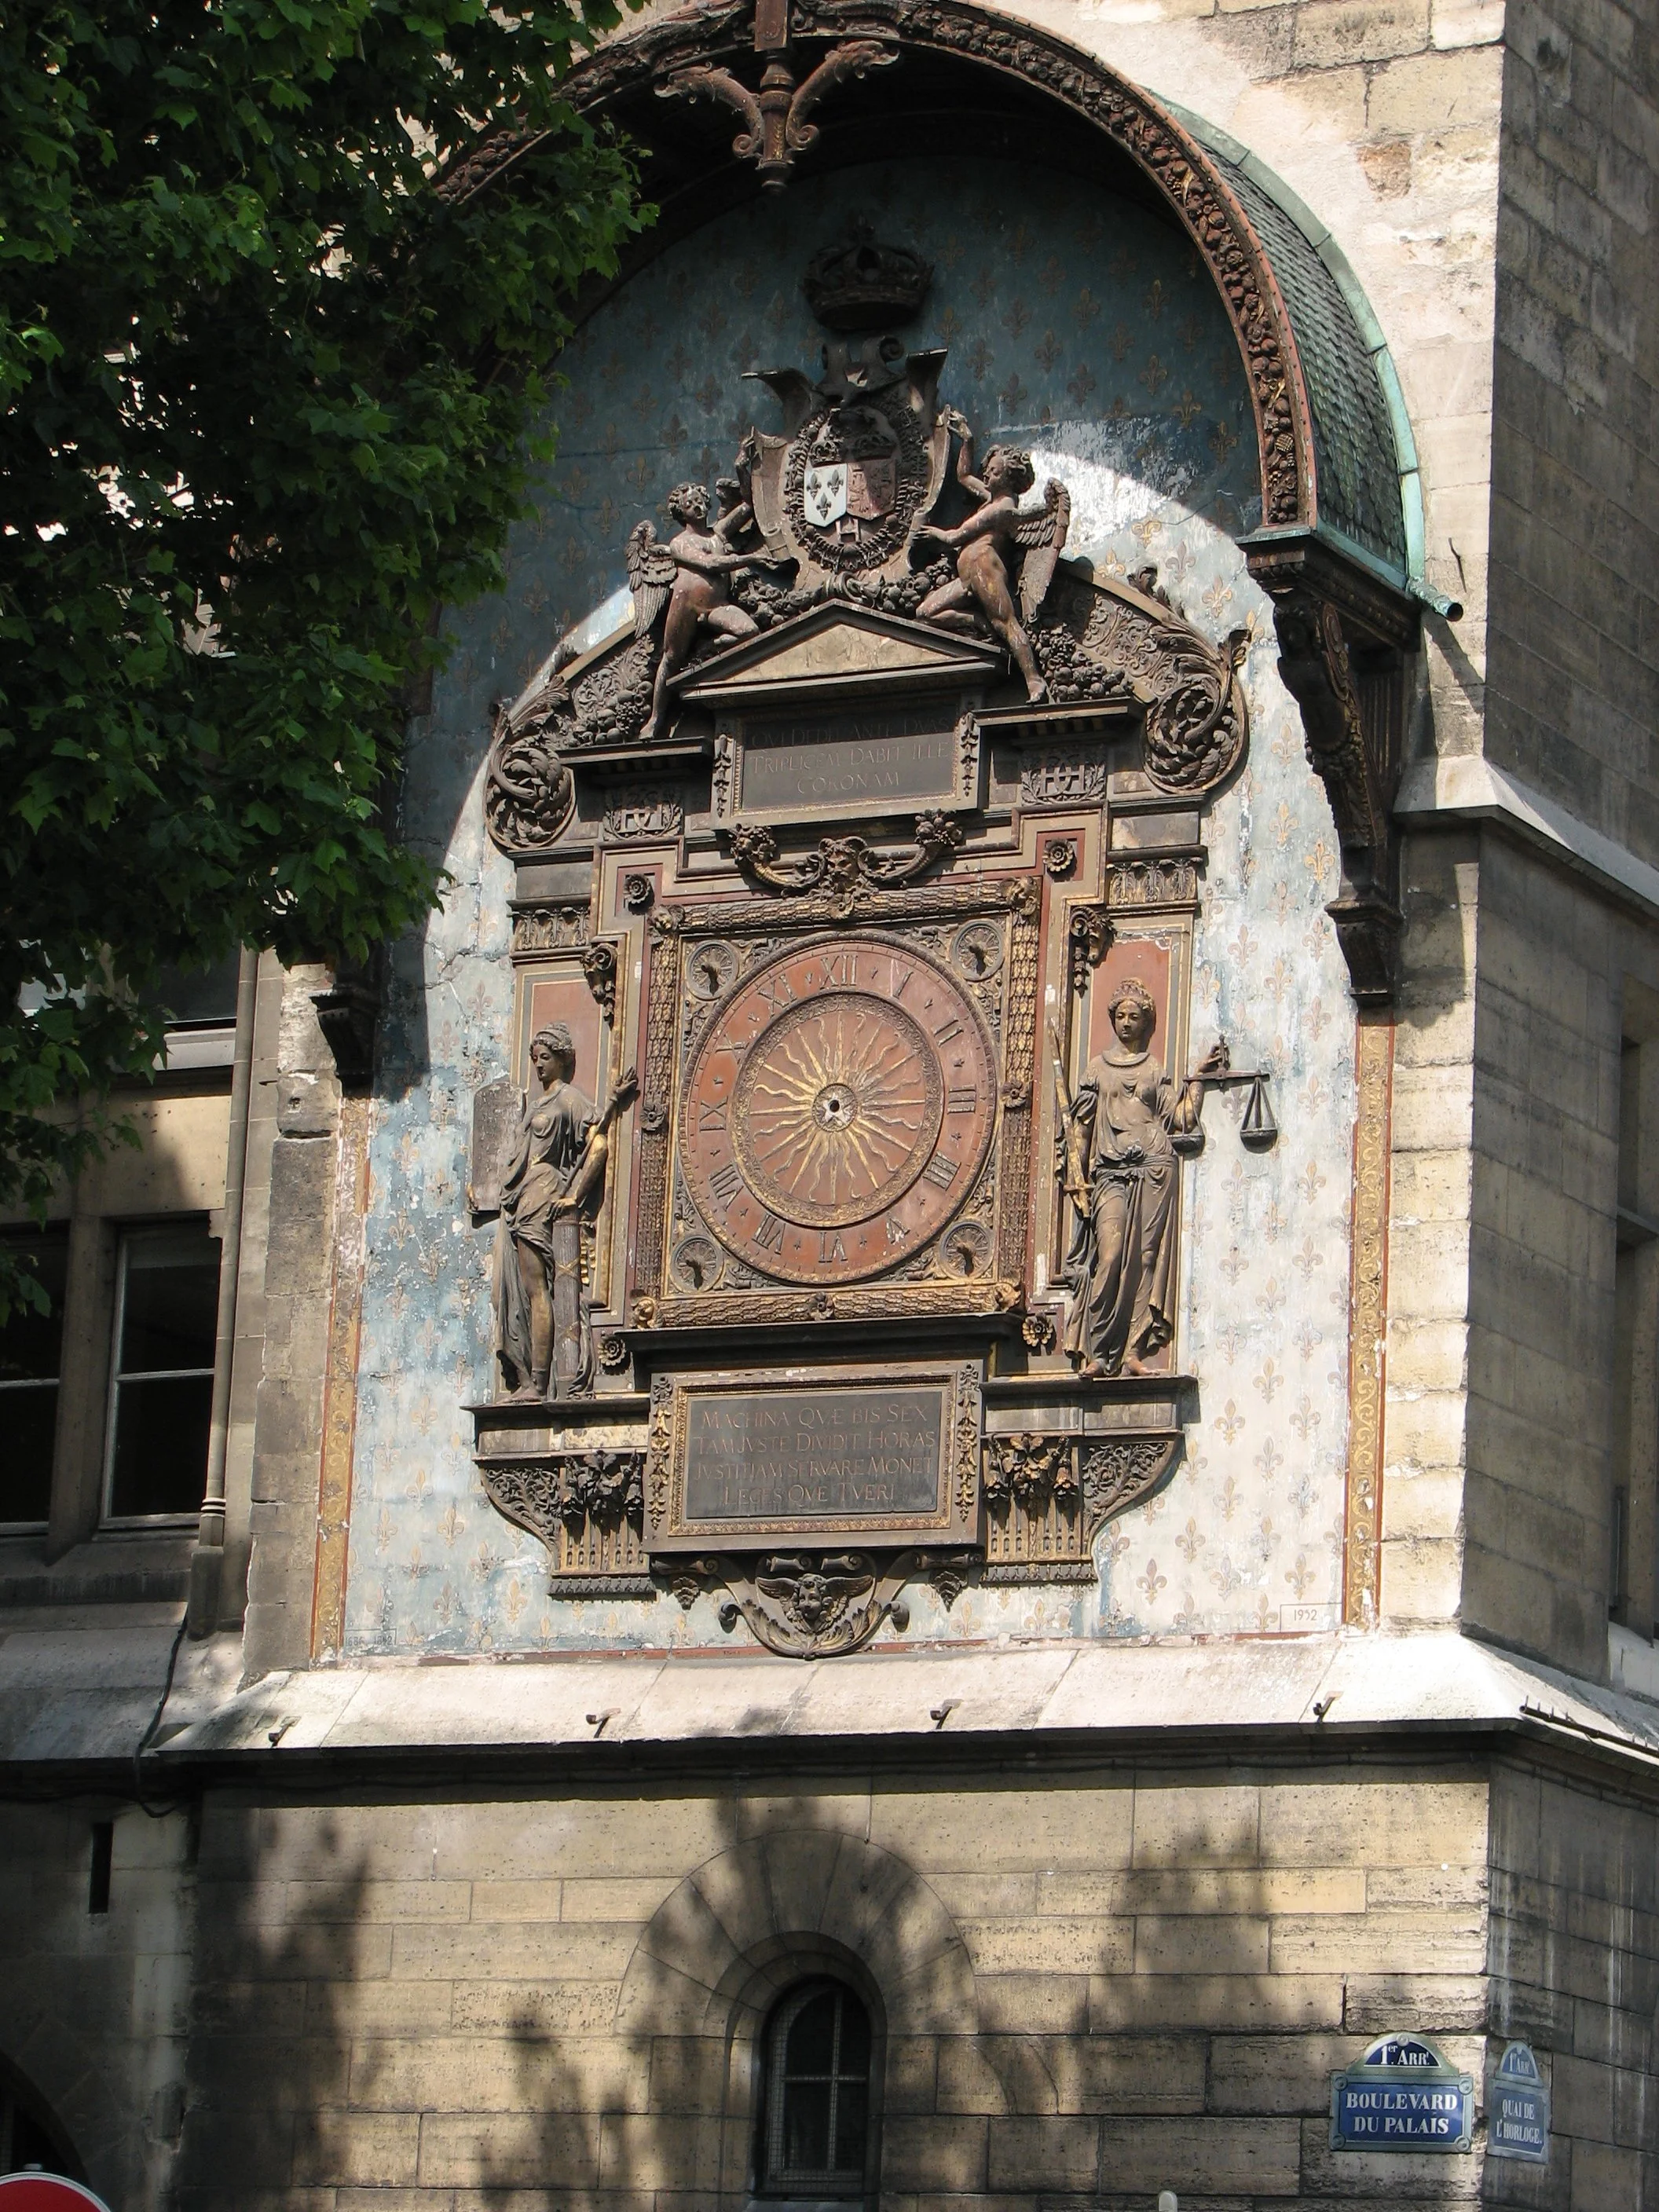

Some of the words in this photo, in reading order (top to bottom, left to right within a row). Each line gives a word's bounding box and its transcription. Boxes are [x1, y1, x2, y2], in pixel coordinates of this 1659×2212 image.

[850, 746, 905, 767] DABIT
[913, 742, 949, 760] ILLE
[797, 771, 899, 795] CORONAM
[819, 955, 858, 987] XII
[758, 976, 797, 1015] XI
[933, 1019, 964, 1046] II
[947, 1084, 976, 1114] III
[700, 1097, 728, 1132] IX
[922, 1151, 961, 1191] IIII
[818, 1232, 848, 1263] VI
[701, 1410, 789, 1430] MACHINA
[887, 1404, 927, 1423] SEX
[693, 1436, 734, 1455] TAM
[868, 1430, 936, 1449] HORAS
[789, 1458, 864, 1478] SERVARE
[868, 1456, 933, 1474] MONET
[839, 1481, 895, 1502] TVERI
[1294, 1609, 1317, 1621] 1952
[1346, 2092, 1458, 2111] BOULEVARD
[1502, 2098, 1522, 2118] QUAI
[1524, 2103, 1535, 2120] DE
[1353, 2116, 1379, 2132] DU
[1384, 2116, 1449, 2135] PALAIS
